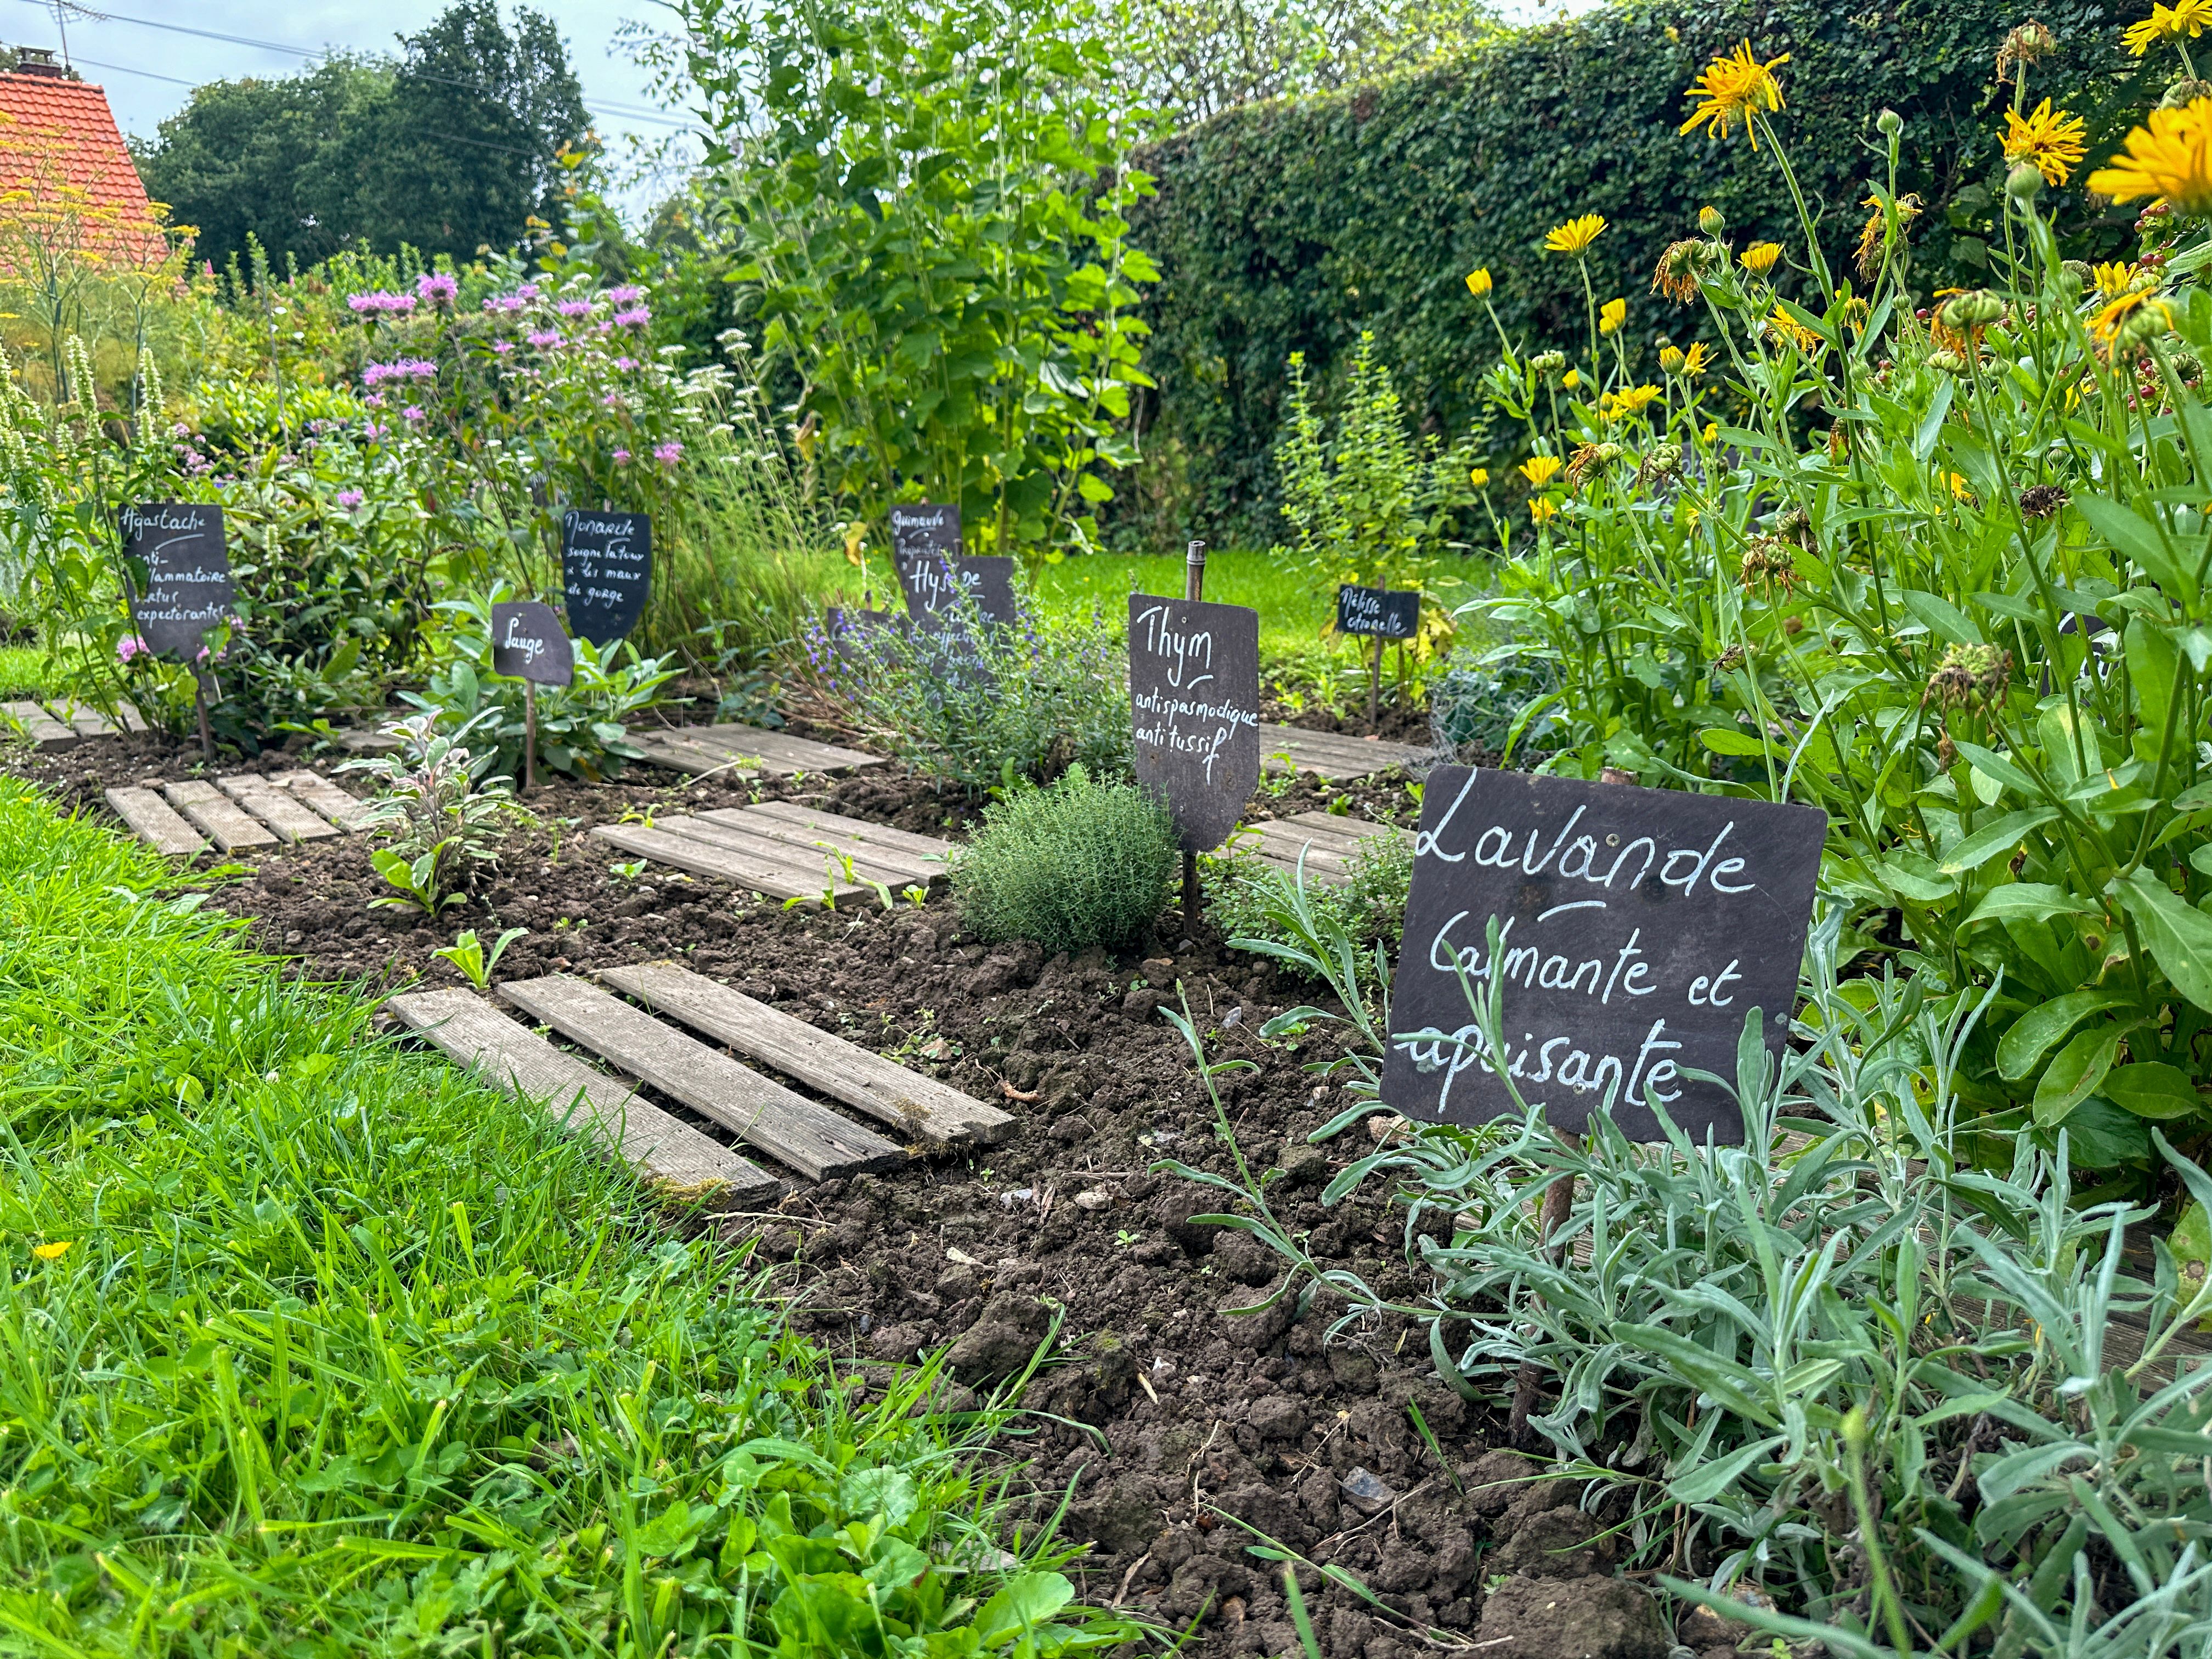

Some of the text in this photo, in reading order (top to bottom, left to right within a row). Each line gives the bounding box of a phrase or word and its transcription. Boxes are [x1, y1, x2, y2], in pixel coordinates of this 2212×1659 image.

[120, 507, 206, 541] Agastache
[565, 510, 635, 545] Monarde
[136, 550, 168, 566] nti-
[605, 569, 642, 581] maux
[582, 586, 624, 610] gorge
[909, 560, 982, 613] Hyspe
[504, 617, 545, 665] Sauge
[1137, 605, 1212, 686] Thym
[1136, 686, 1259, 740] antispasmodique
[1414, 766, 1756, 897] Lavande
[1430, 910, 1742, 1007] Calmante et
